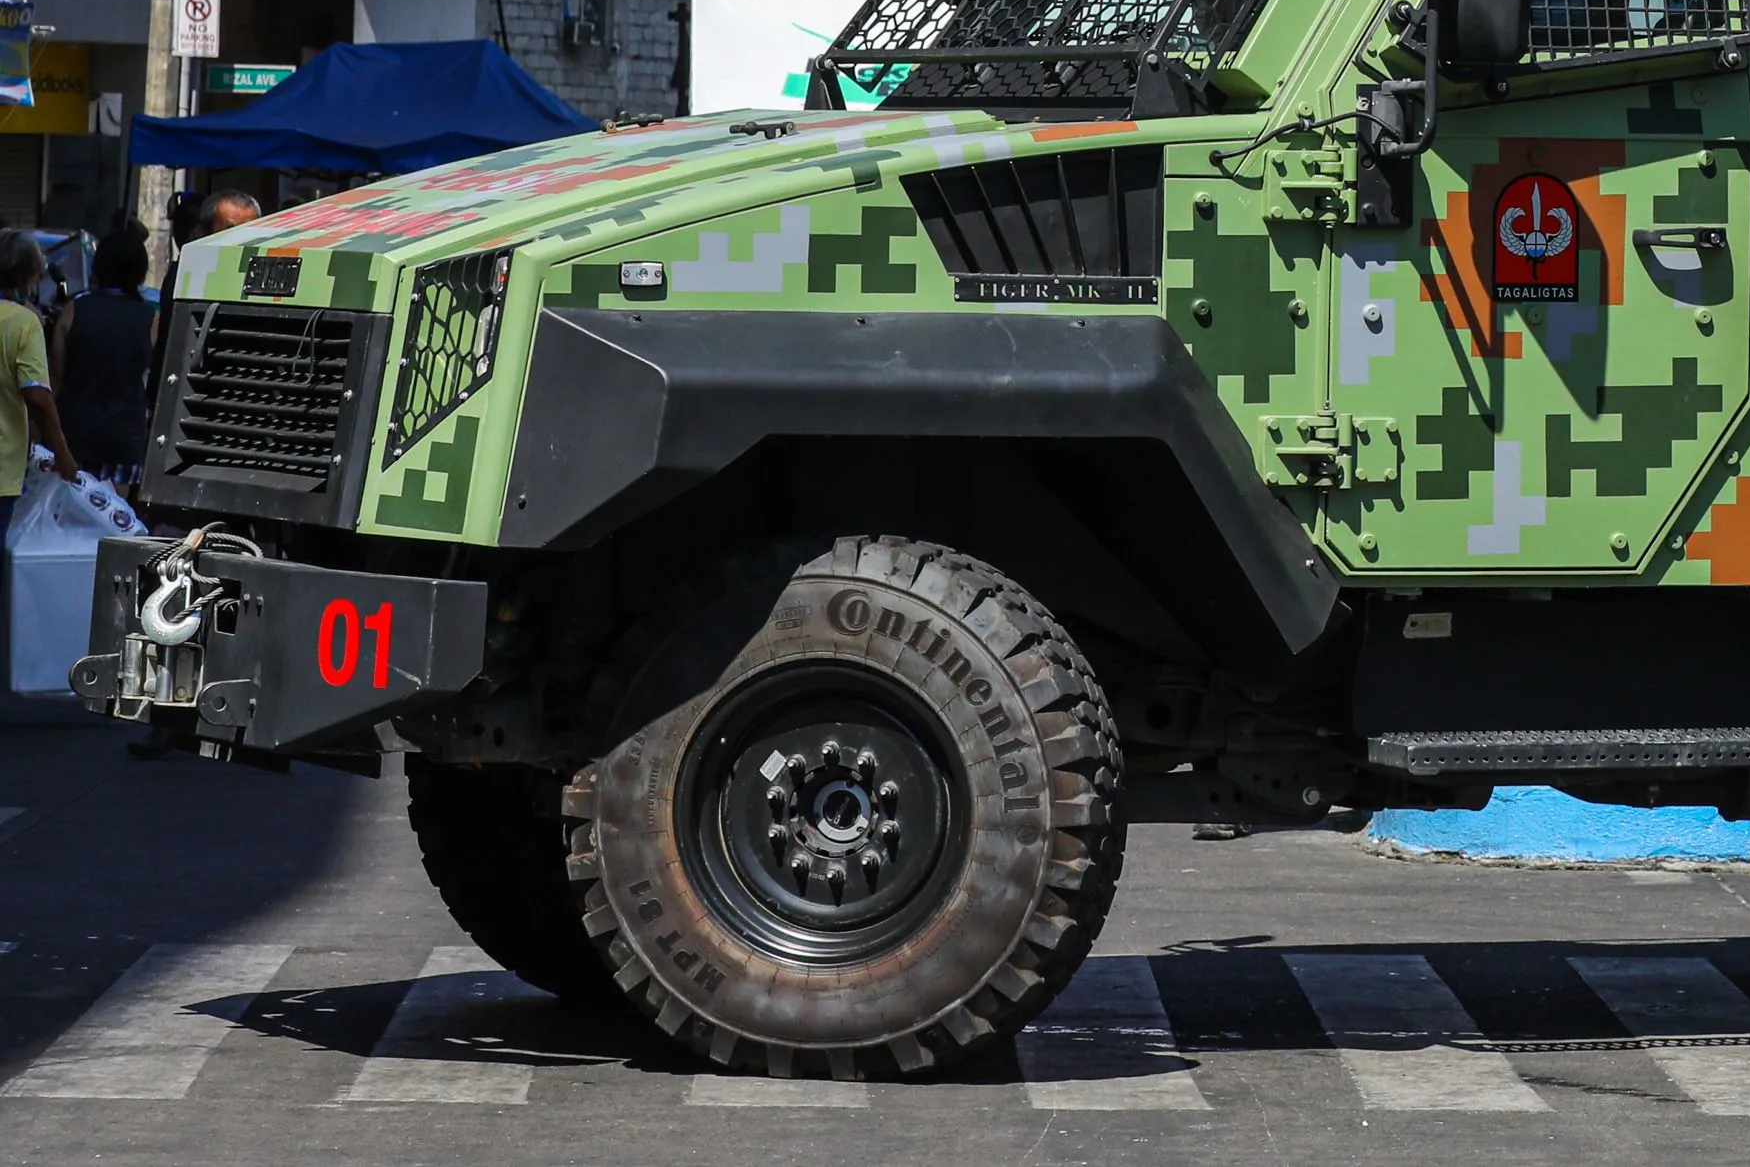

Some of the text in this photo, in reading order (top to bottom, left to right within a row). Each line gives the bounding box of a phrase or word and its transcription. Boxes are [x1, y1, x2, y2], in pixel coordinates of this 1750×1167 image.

[188, 23, 208, 33] NO
[222, 72, 254, 86] RIZAL
[976, 283, 1050, 298] TIGER
[1496, 287, 1575, 298] TAGALIGTAS
[317, 597, 394, 689] 01
[827, 588, 1040, 814] Continental
[628, 880, 727, 994] MPT 81
